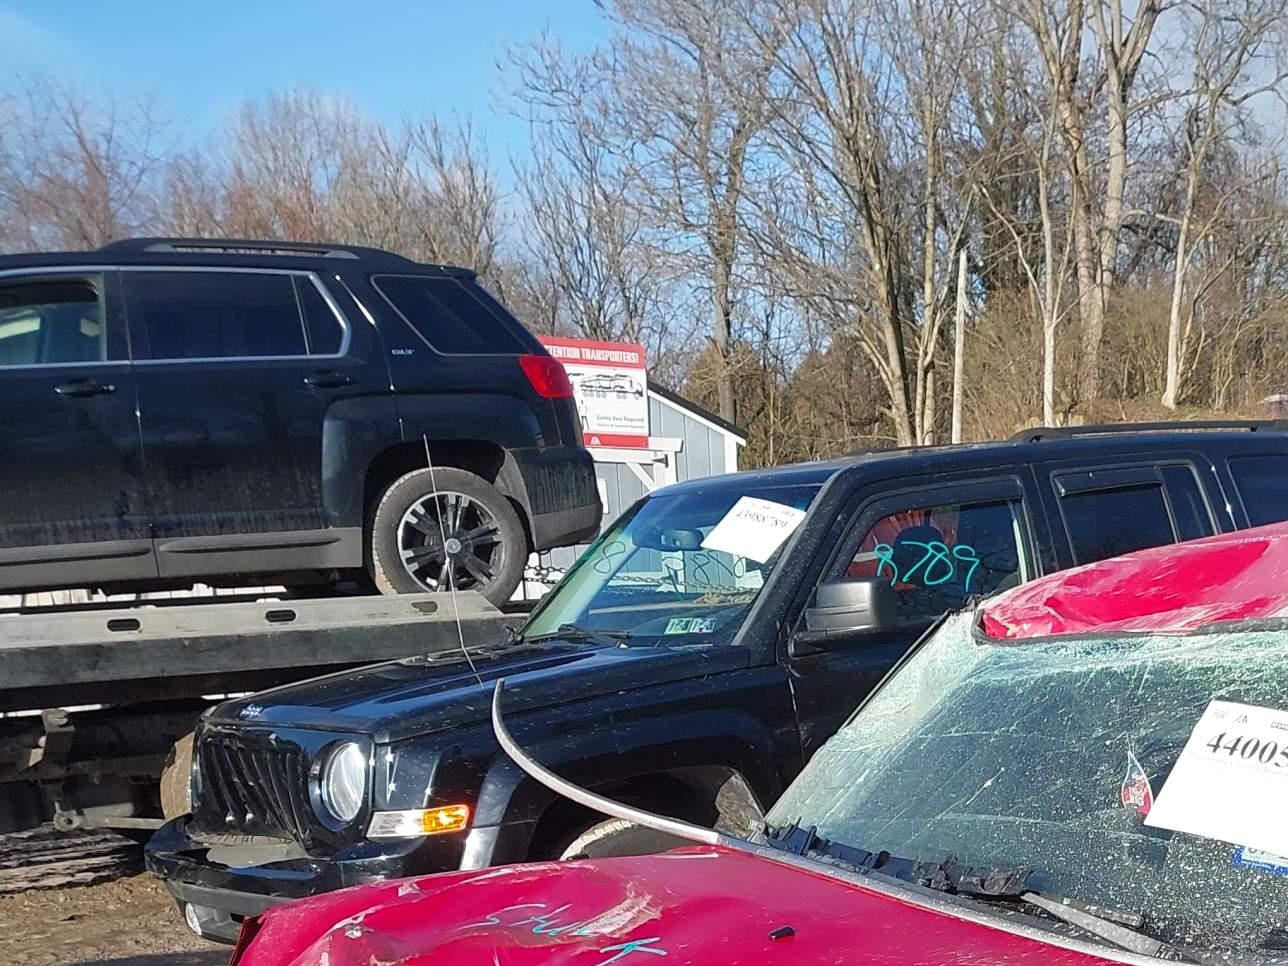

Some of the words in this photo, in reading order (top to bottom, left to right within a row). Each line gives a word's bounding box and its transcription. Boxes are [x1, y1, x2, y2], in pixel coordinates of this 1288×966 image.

[545, 344, 580, 359] TENTION
[581, 348, 638, 363] TRANSPORTERS!
[874, 540, 980, 593] 8789
